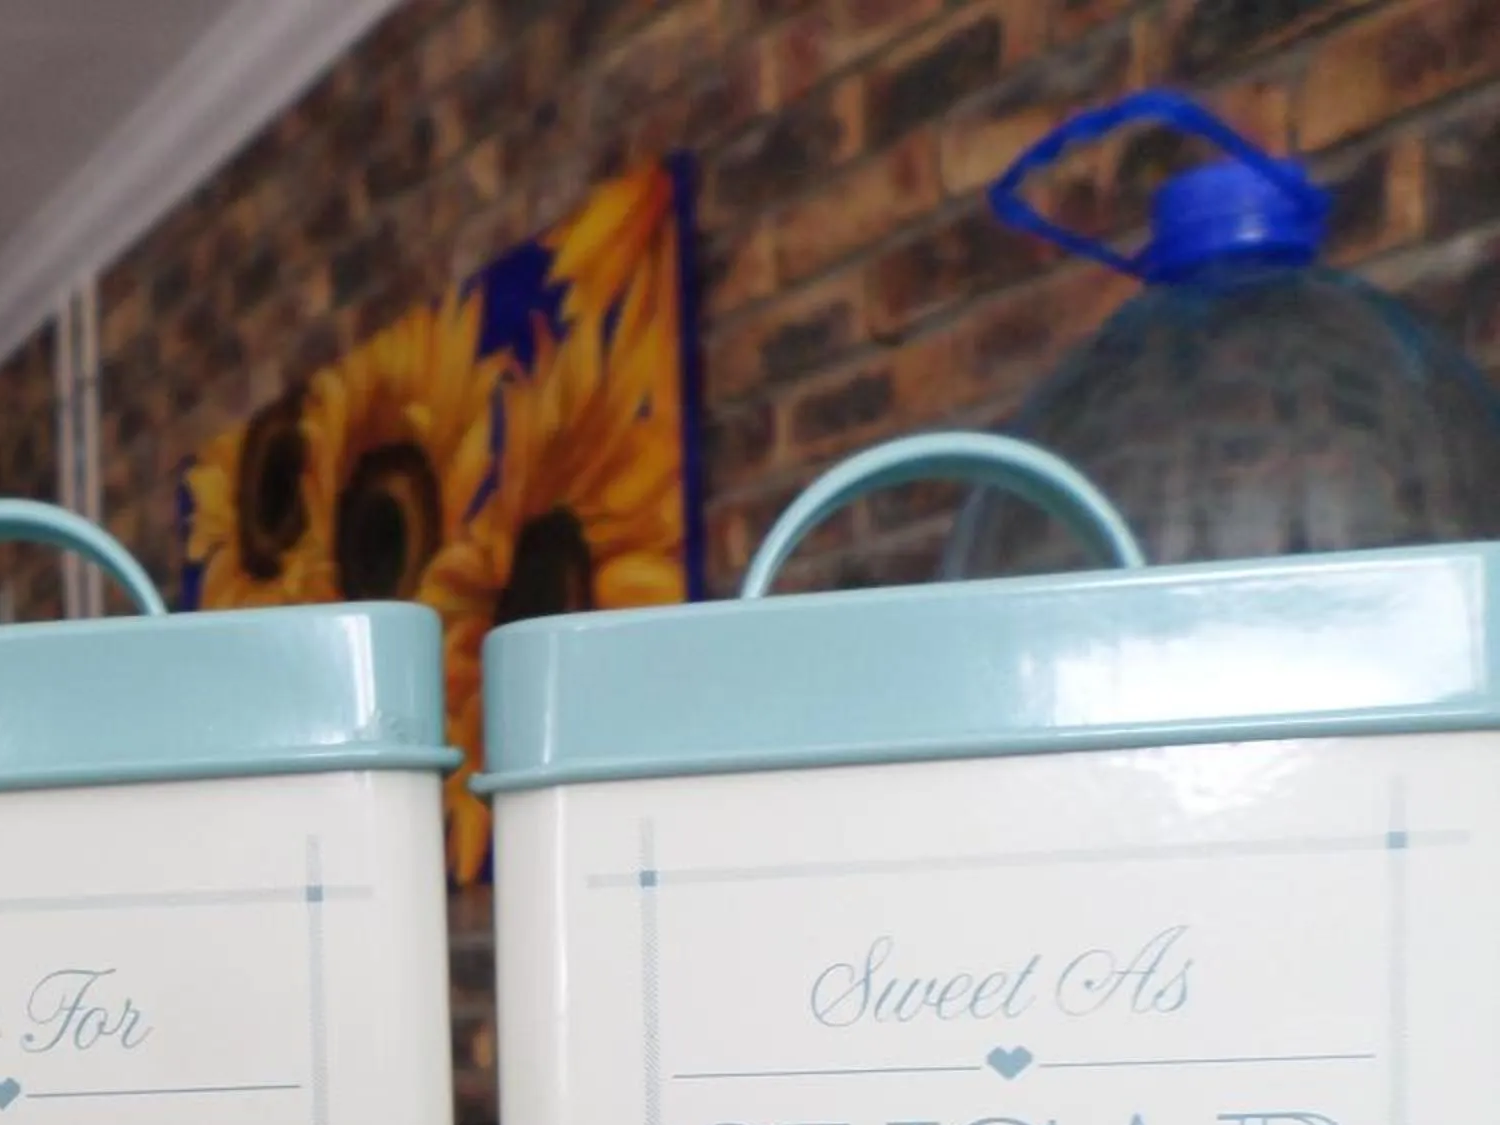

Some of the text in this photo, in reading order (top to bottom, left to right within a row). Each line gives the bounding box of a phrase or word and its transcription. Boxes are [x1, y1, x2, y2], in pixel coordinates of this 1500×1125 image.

[21, 967, 154, 1054] For
[810, 924, 1194, 1027] Sweet As
